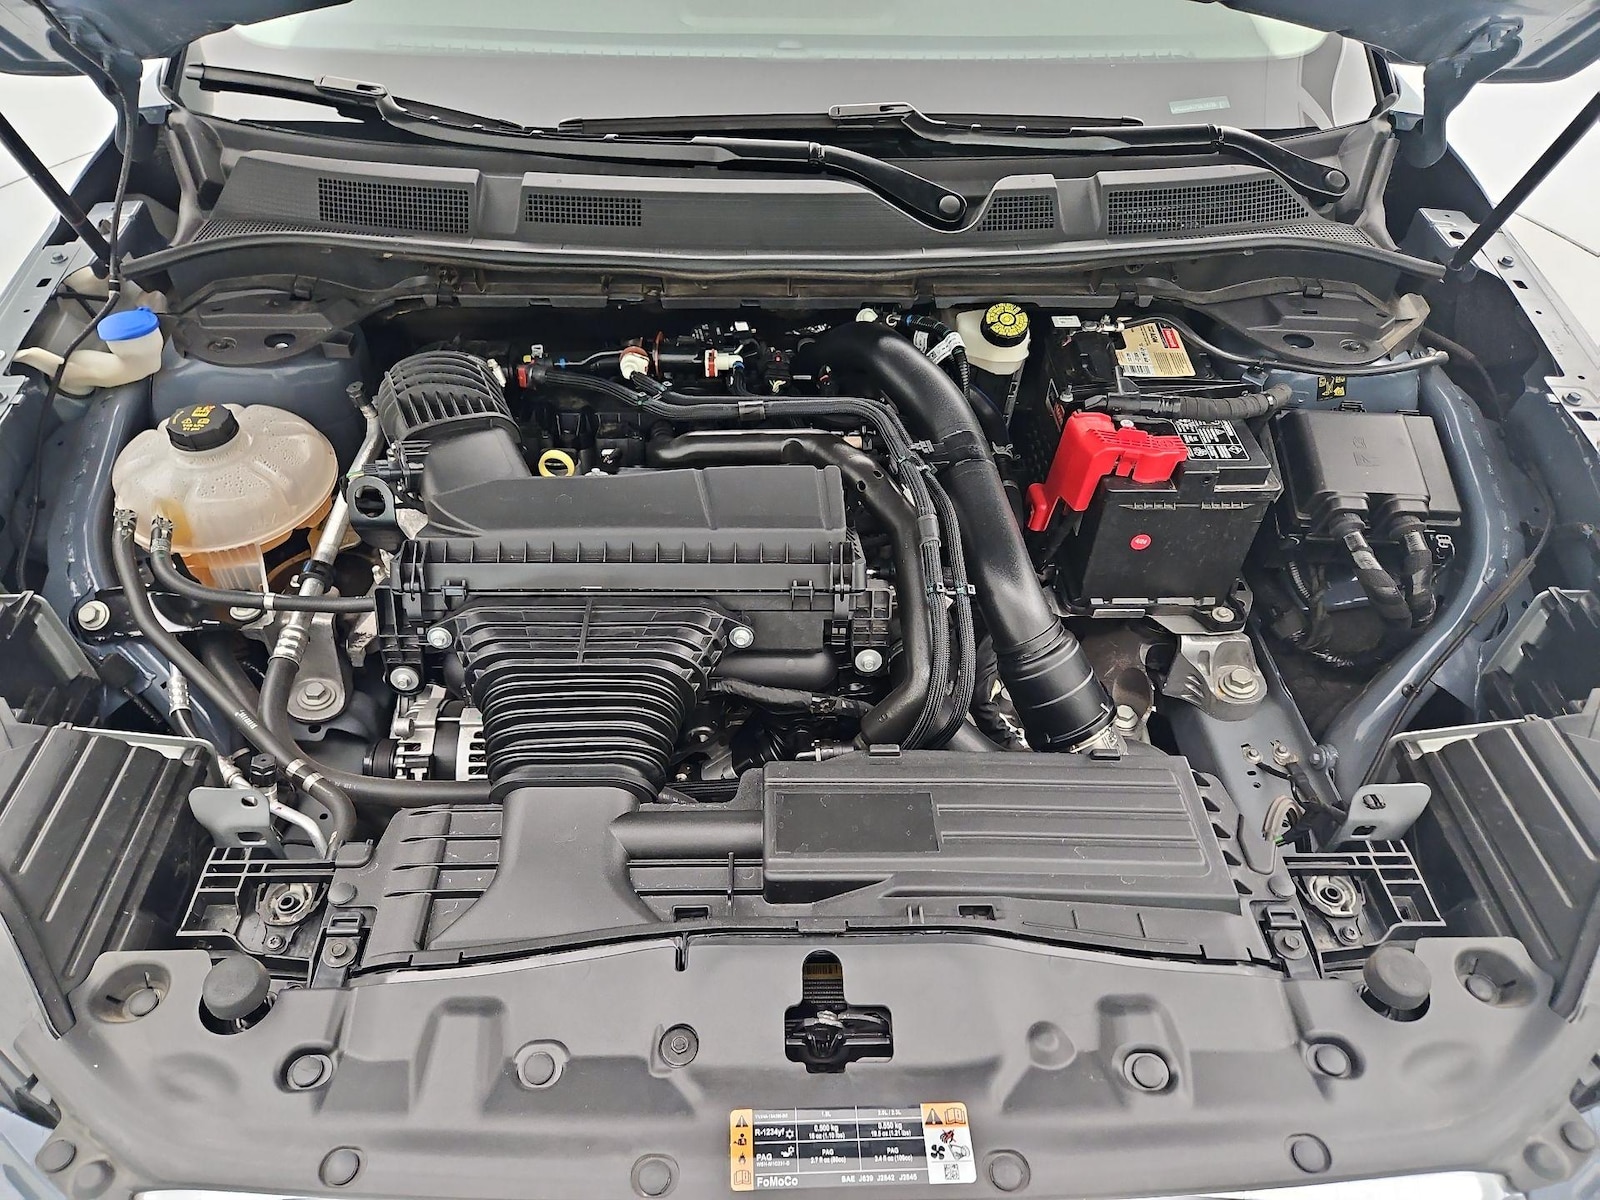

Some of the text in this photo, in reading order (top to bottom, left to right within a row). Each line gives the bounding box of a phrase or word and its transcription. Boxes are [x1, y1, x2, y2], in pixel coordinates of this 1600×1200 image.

[829, 1124, 839, 1133] kg
[893, 1122, 902, 1131] kg
[755, 1127, 784, 1138] R-1234yf
[822, 1148, 834, 1156] PAG
[756, 1153, 772, 1162] PAG
[757, 1176, 798, 1187] FoMoCo
[842, 1174, 855, 1183] SAE
